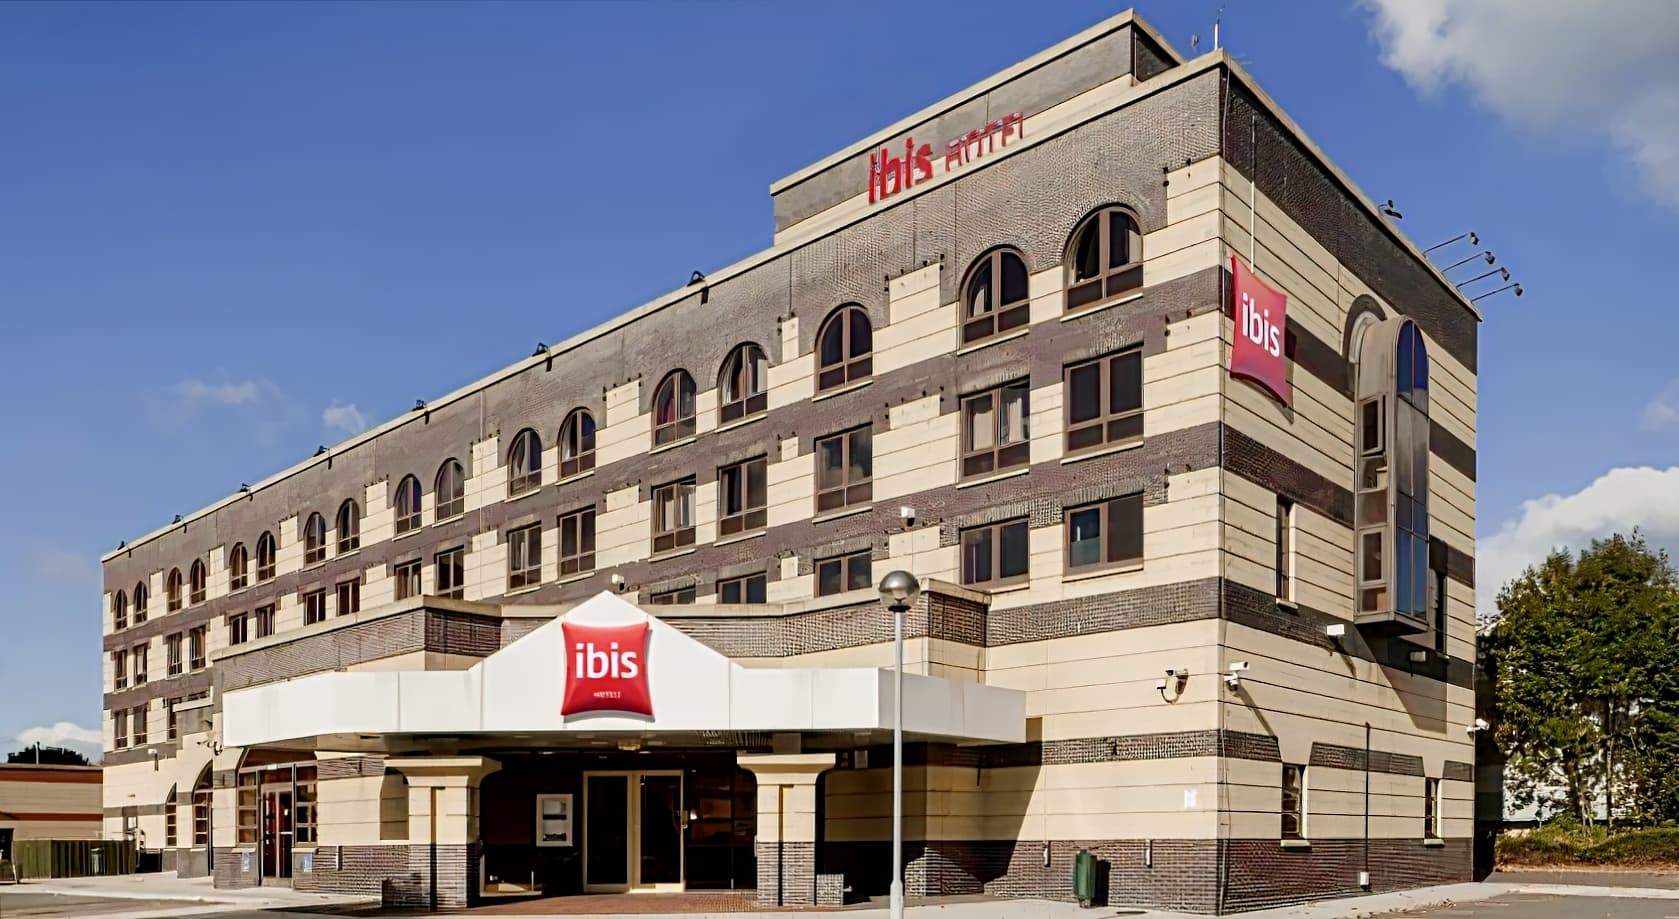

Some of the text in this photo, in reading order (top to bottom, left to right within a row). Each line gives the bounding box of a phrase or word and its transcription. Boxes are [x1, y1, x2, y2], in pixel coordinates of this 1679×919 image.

[869, 136, 934, 205] ibis
[1242, 292, 1280, 357] ibis
[576, 641, 639, 679] ibis
